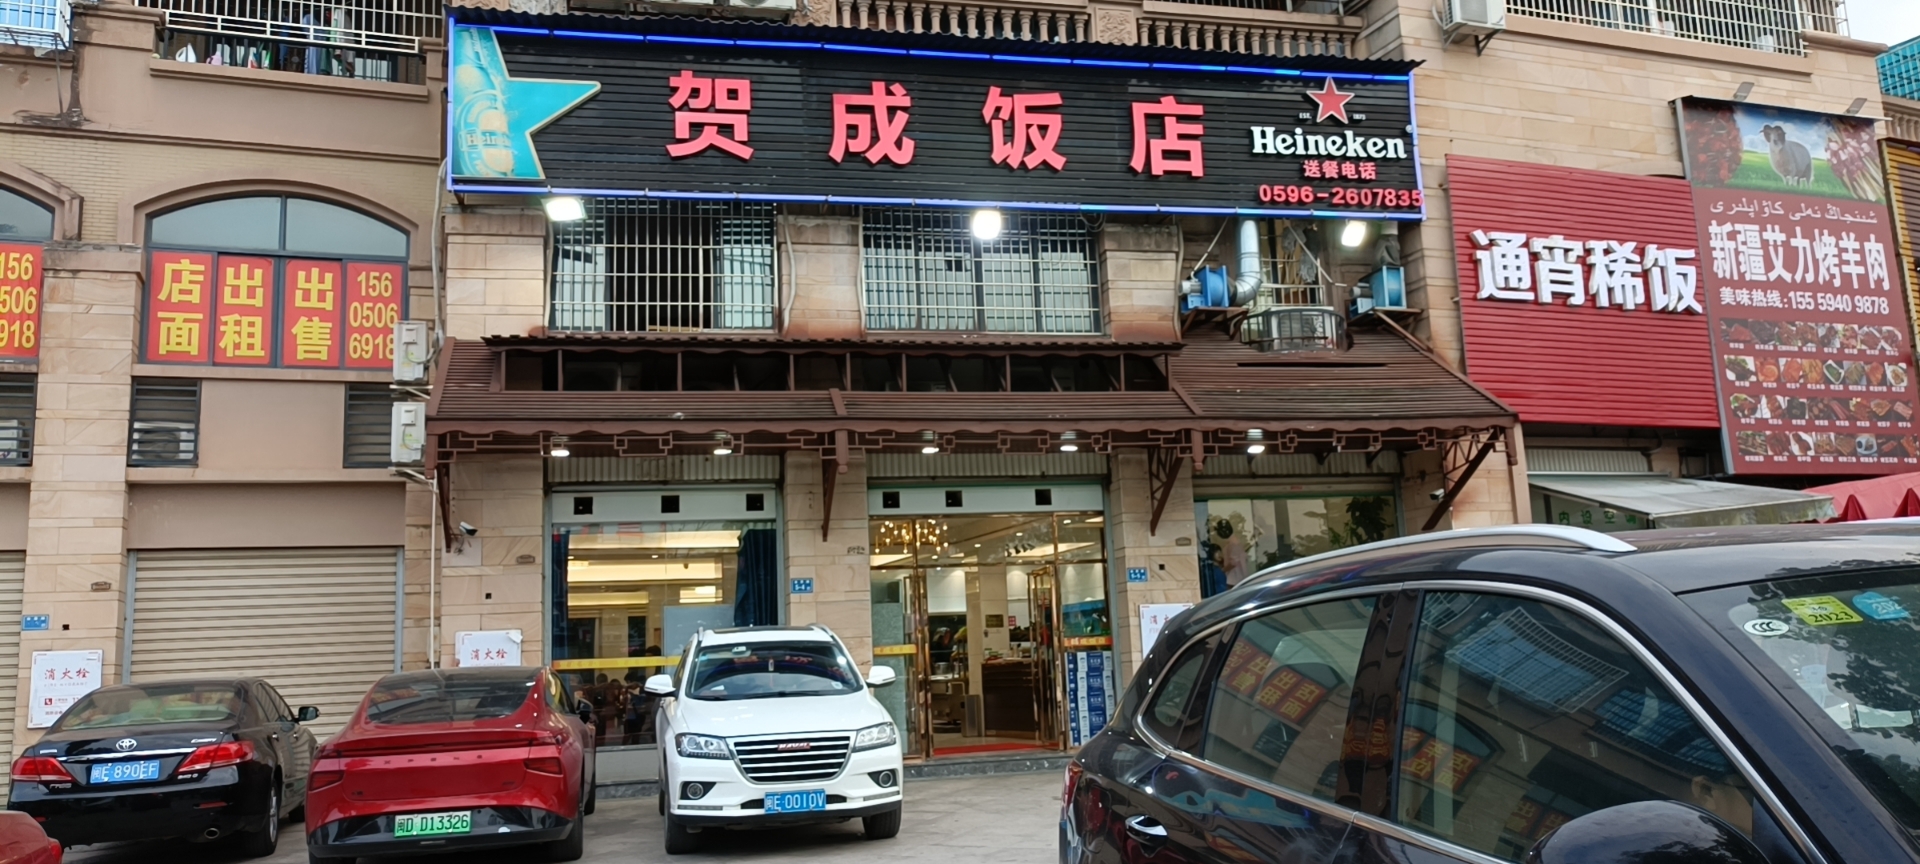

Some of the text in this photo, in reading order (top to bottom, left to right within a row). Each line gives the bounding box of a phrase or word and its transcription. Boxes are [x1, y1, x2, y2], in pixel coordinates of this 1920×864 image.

[666, 70, 1204, 177] 贺成饭店
[1251, 126, 1407, 159] Heineken
[1303, 160, 1376, 180] 送餐电话
[1259, 184, 1423, 206] 0596-2607835
[0, 252, 34, 280] 156
[1708, 219, 1890, 291] 新疆艾力烤羊肉
[357, 272, 393, 297] 156
[1469, 229, 1703, 314] 通宵稀饭
[158, 259, 205, 356] 店面
[219, 263, 264, 357] 出租
[291, 267, 333, 361] 出售
[349, 302, 398, 329] 0506
[1818, 293, 1852, 312] 5940
[1855, 296, 1889, 315] 9878
[349, 332, 394, 360] 6918
[1809, 611, 1854, 623] 2023
[470, 648, 507, 660] 消火栓
[45, 668, 90, 680] 消火栓
